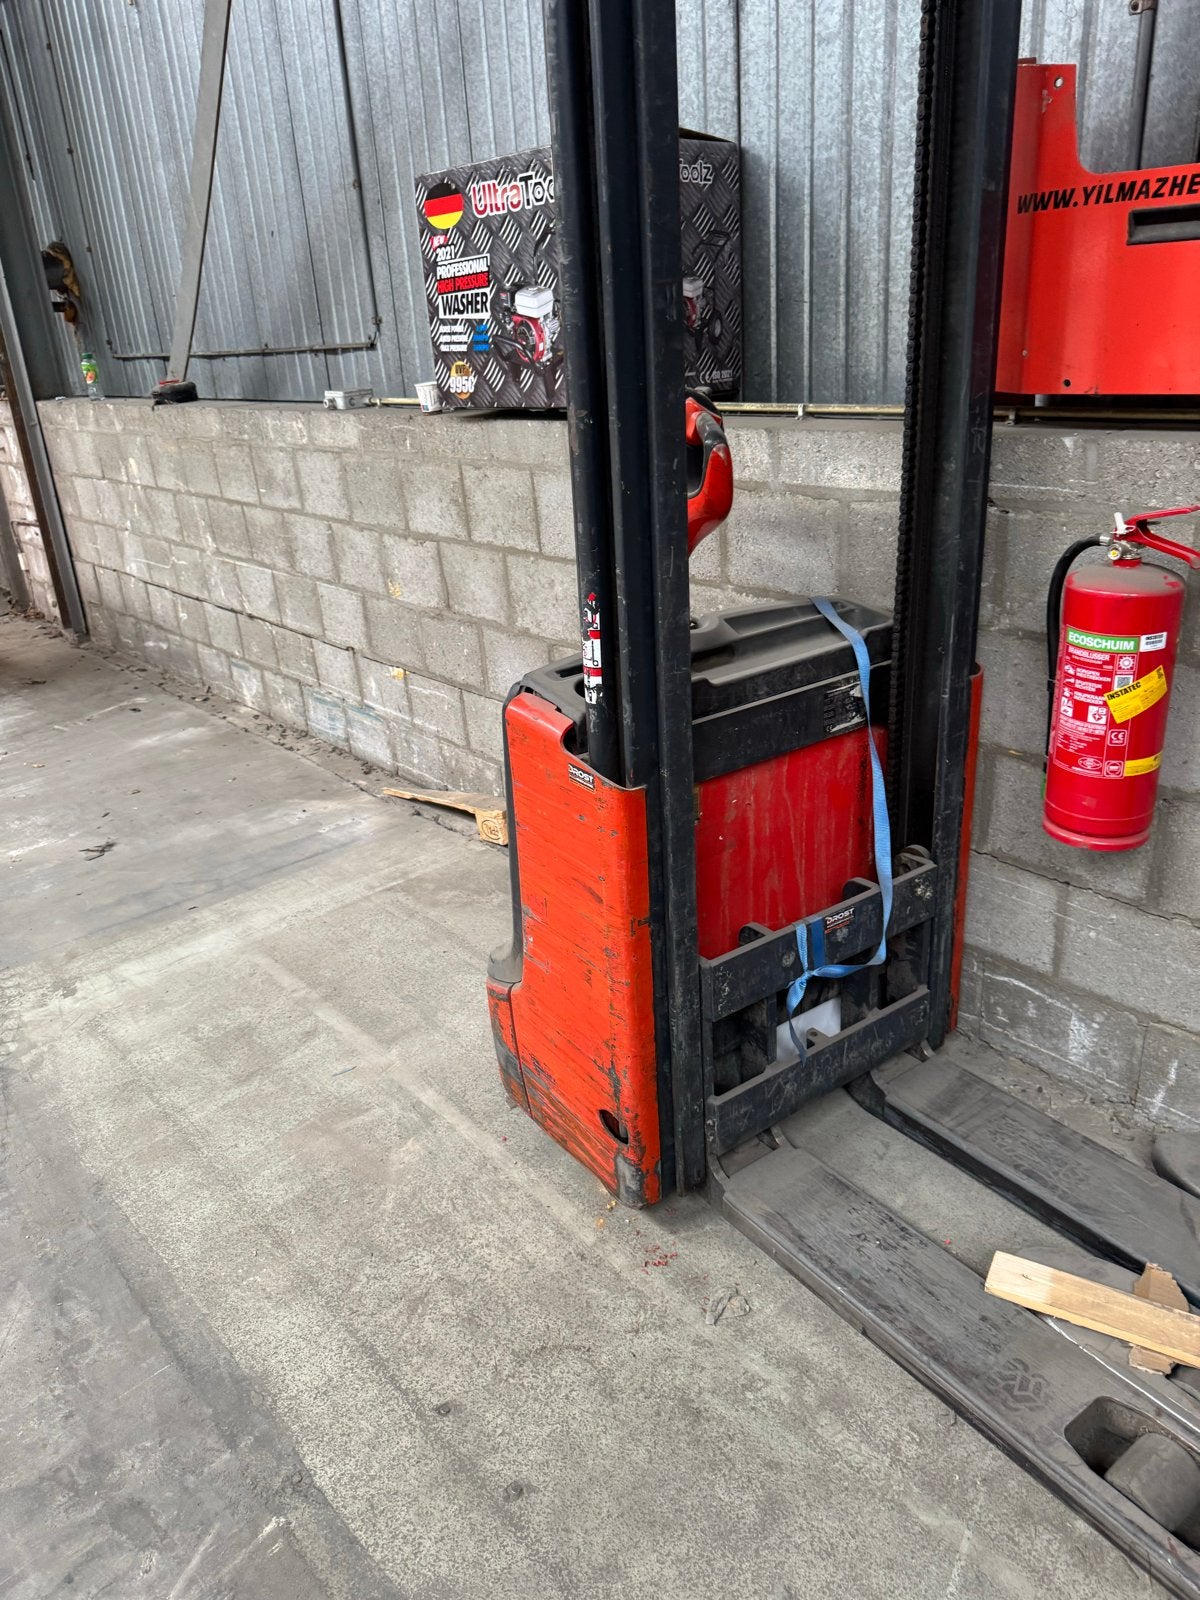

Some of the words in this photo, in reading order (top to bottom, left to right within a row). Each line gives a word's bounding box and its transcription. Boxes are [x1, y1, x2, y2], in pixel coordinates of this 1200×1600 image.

[436, 245, 455, 261] 2021
[436, 257, 489, 279] PROFESSIONAL
[437, 278, 455, 294] HIGH
[455, 272, 489, 291] PRESSURE
[441, 291, 489, 316] WASHER
[1068, 631, 1135, 651] ECOSCHUIM
[1107, 682, 1142, 700] INSTATEC
